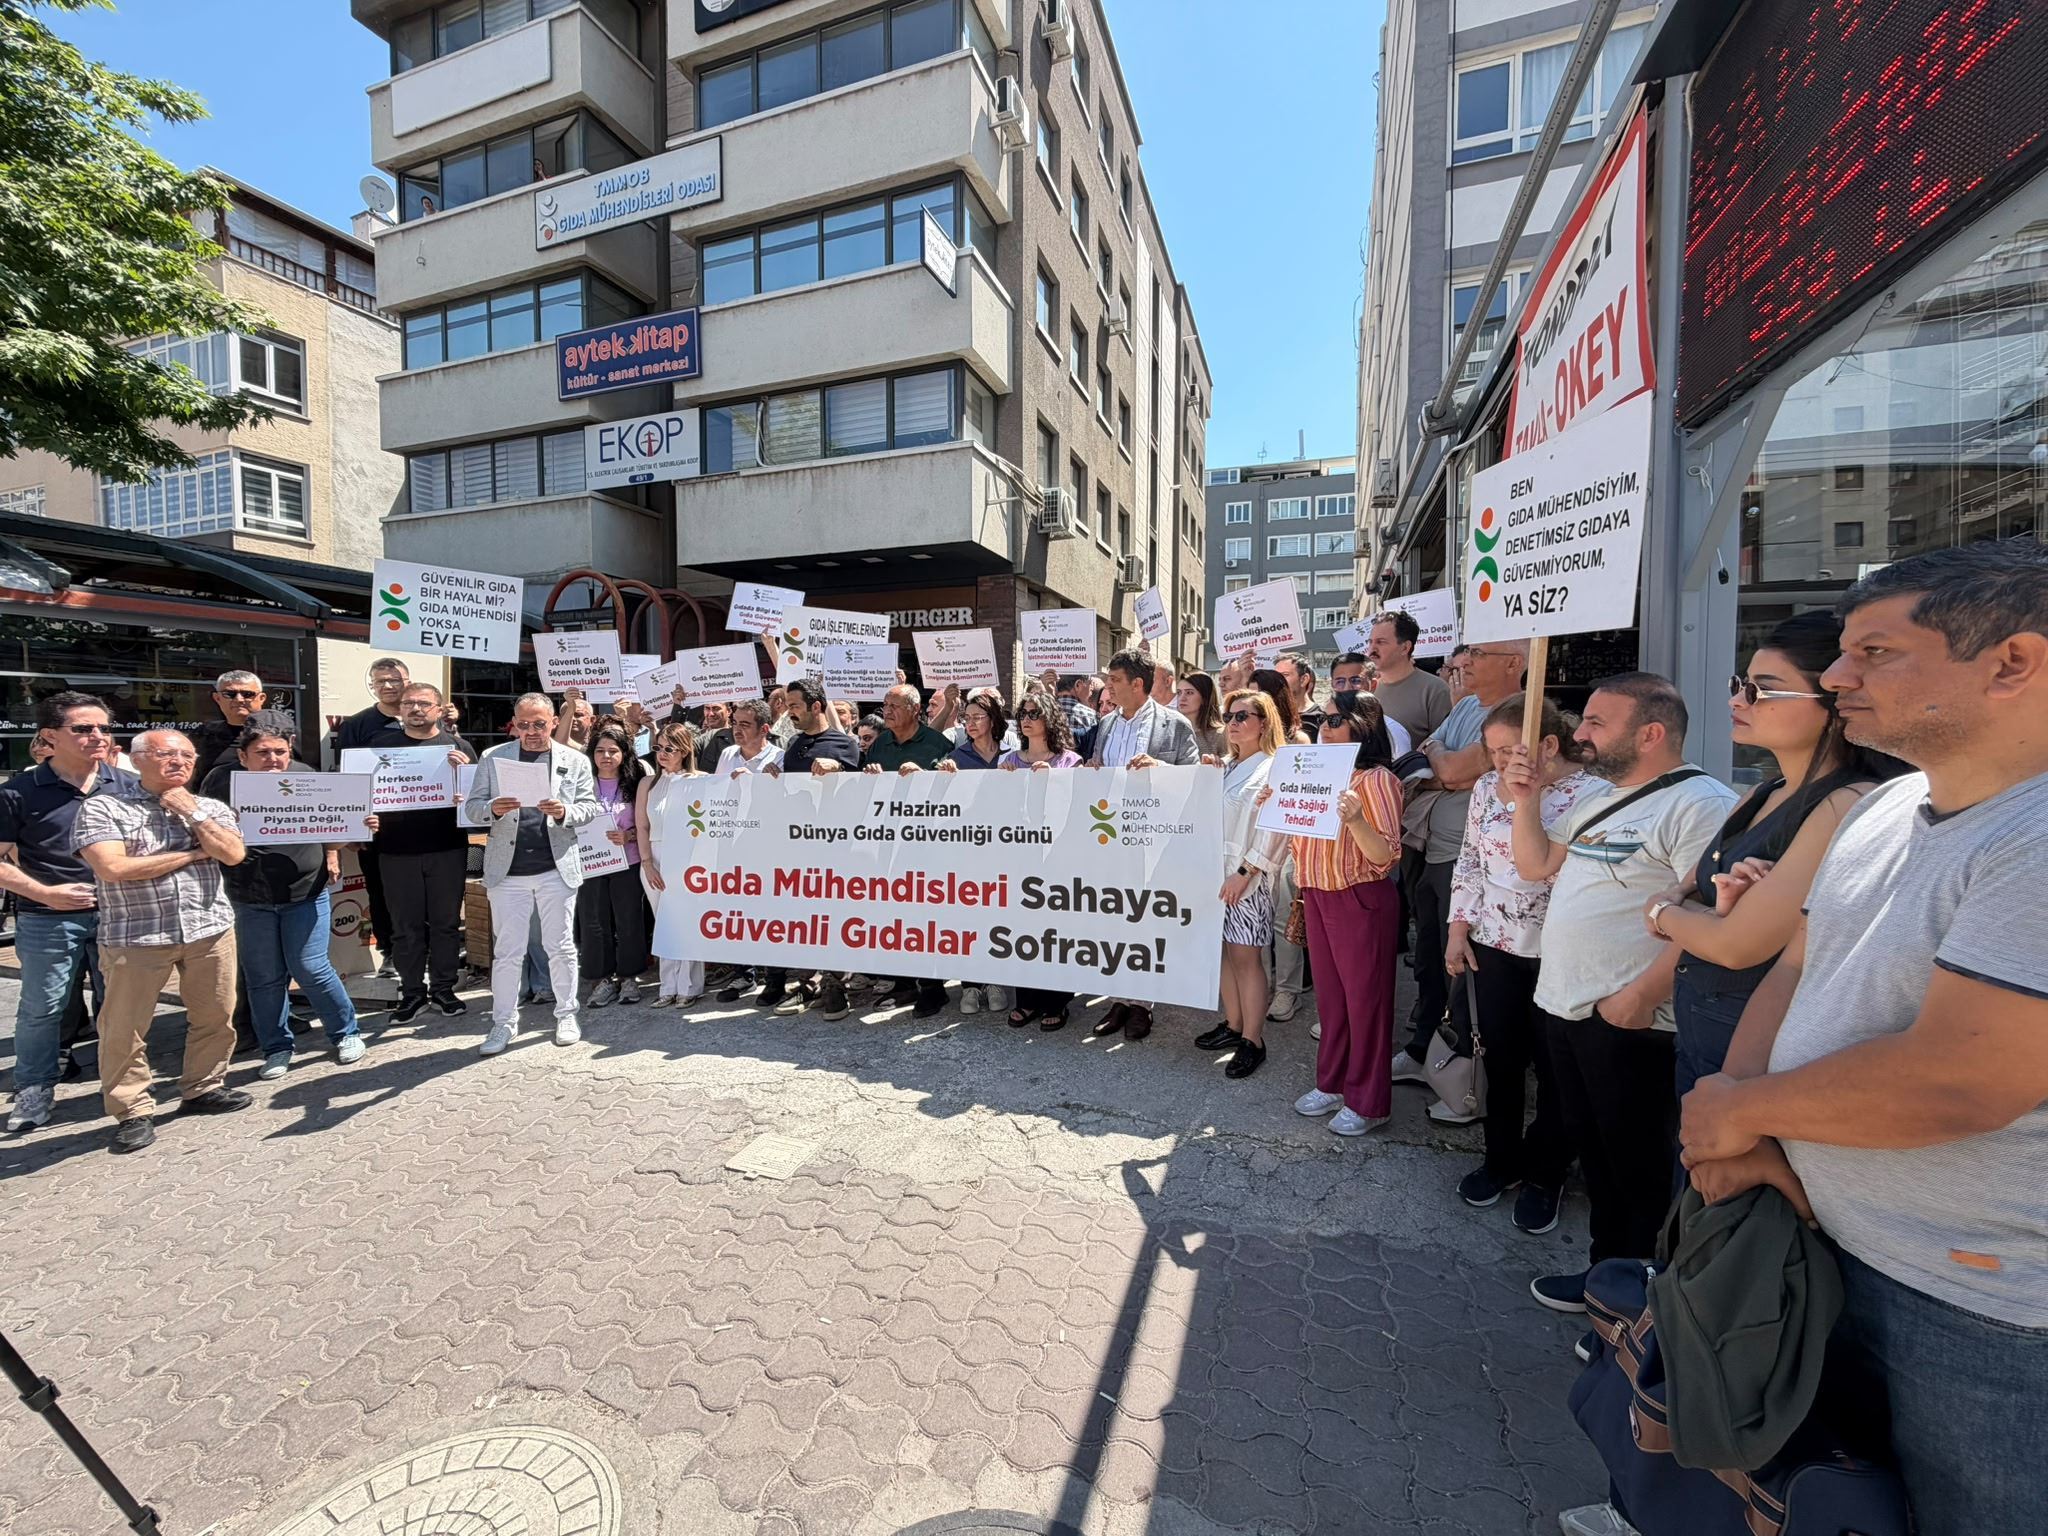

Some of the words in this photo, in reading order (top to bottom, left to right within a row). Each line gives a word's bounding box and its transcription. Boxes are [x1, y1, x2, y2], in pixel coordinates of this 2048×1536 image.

[594, 169, 650, 198] TMMOB
[560, 212, 588, 233] GIDA
[589, 183, 674, 224] MÜHENDİSLERİ
[678, 174, 717, 200] ODASI
[565, 332, 627, 370] aytek
[567, 373, 599, 389] kültür
[608, 366, 639, 382] sanat
[642, 356, 688, 376] merkezi
[600, 417, 683, 463] EKOP
[1510, 476, 1533, 500] BEN
[1508, 506, 1534, 528] GIDA
[1537, 472, 1639, 520] MÜHENDİSİYİM,
[1505, 521, 1574, 556] DENETİMSİZ
[1578, 509, 1631, 539] GIDAYA
[1503, 548, 1605, 583] GÜVENMİYORUM,
[421, 572, 485, 591] GÜVENİLİR
[488, 581, 516, 595] GIDA
[420, 586, 441, 600] BİR
[444, 590, 482, 605] HAYAL
[486, 595, 505, 607] Mİ?
[1503, 593, 1523, 618] YA
[1528, 584, 1568, 615] SİZ?
[419, 602, 449, 615] GIDA
[452, 605, 516, 623] MÜHENDİSİ
[884, 607, 974, 628] BURGER
[418, 616, 461, 631] YOKSA
[810, 618, 826, 631] GIDA
[828, 618, 886, 638] İŞLETMELERİNDE
[1241, 617, 1262, 627] Gıda
[1430, 624, 1453, 634] Değil
[1223, 622, 1289, 642] Güvenliğinden
[420, 631, 489, 652] EVET!
[1224, 640, 1258, 653] Tasarruf
[1261, 634, 1293, 646] Olmaz
[1428, 635, 1453, 645] Bütçe
[548, 657, 581, 667] Güvenli
[583, 657, 606, 665] Gıda
[547, 667, 582, 677] Seçenek
[584, 666, 610, 676] Değil
[691, 675, 708, 683] Gıda
[709, 671, 744, 680] Mühendisi
[551, 678, 610, 687] Zorunluluktur
[704, 680, 735, 688] Olmadan
[702, 688, 734, 698] Güvenliği
[735, 684, 757, 694] Olmaz
[126, 721, 149, 729] saat
[150, 721, 176, 729] 12:00
[378, 775, 423, 783] Herkese
[401, 783, 443, 794] Dengeli
[1279, 782, 1299, 794] Gıda
[1300, 783, 1332, 795] Hileleri
[372, 796, 416, 805] Güvenli
[419, 794, 445, 802] Gıda
[709, 799, 739, 807] TMMOB
[1122, 798, 1160, 808] TMMOB
[1277, 797, 1297, 809] Halk
[1298, 799, 1329, 814] Sağlığı
[240, 804, 314, 813] Mühendisin
[318, 803, 366, 812] Ücretini
[873, 801, 883, 816] 7
[889, 801, 961, 818] Haziran
[264, 816, 305, 825] Piyasa
[309, 815, 345, 824] Değil,
[1122, 811, 1147, 820] GIDA
[1284, 813, 1316, 827] Tehdidi
[259, 826, 296, 835] Odası
[300, 825, 349, 834] Belirler!
[709, 819, 760, 829] MÜHENDİSLERİ
[1122, 822, 1194, 835] MÜHENDİSLERİ
[709, 830, 734, 839] ODASI
[789, 824, 848, 843] Dünya
[853, 825, 895, 841] Gıda
[901, 825, 992, 847] Güvenliği
[998, 826, 1052, 844] Günü
[1122, 837, 1153, 847] ODASI
[584, 858, 623, 872] Hakkıdır
[684, 865, 762, 896] Gıda
[774, 867, 1007, 908] Mühendisleri
[1020, 876, 1191, 927] Sahaya,
[699, 911, 829, 946] Güvenli
[840, 918, 977, 956] Gıdalar
[988, 926, 1167, 975] Sofraya!
